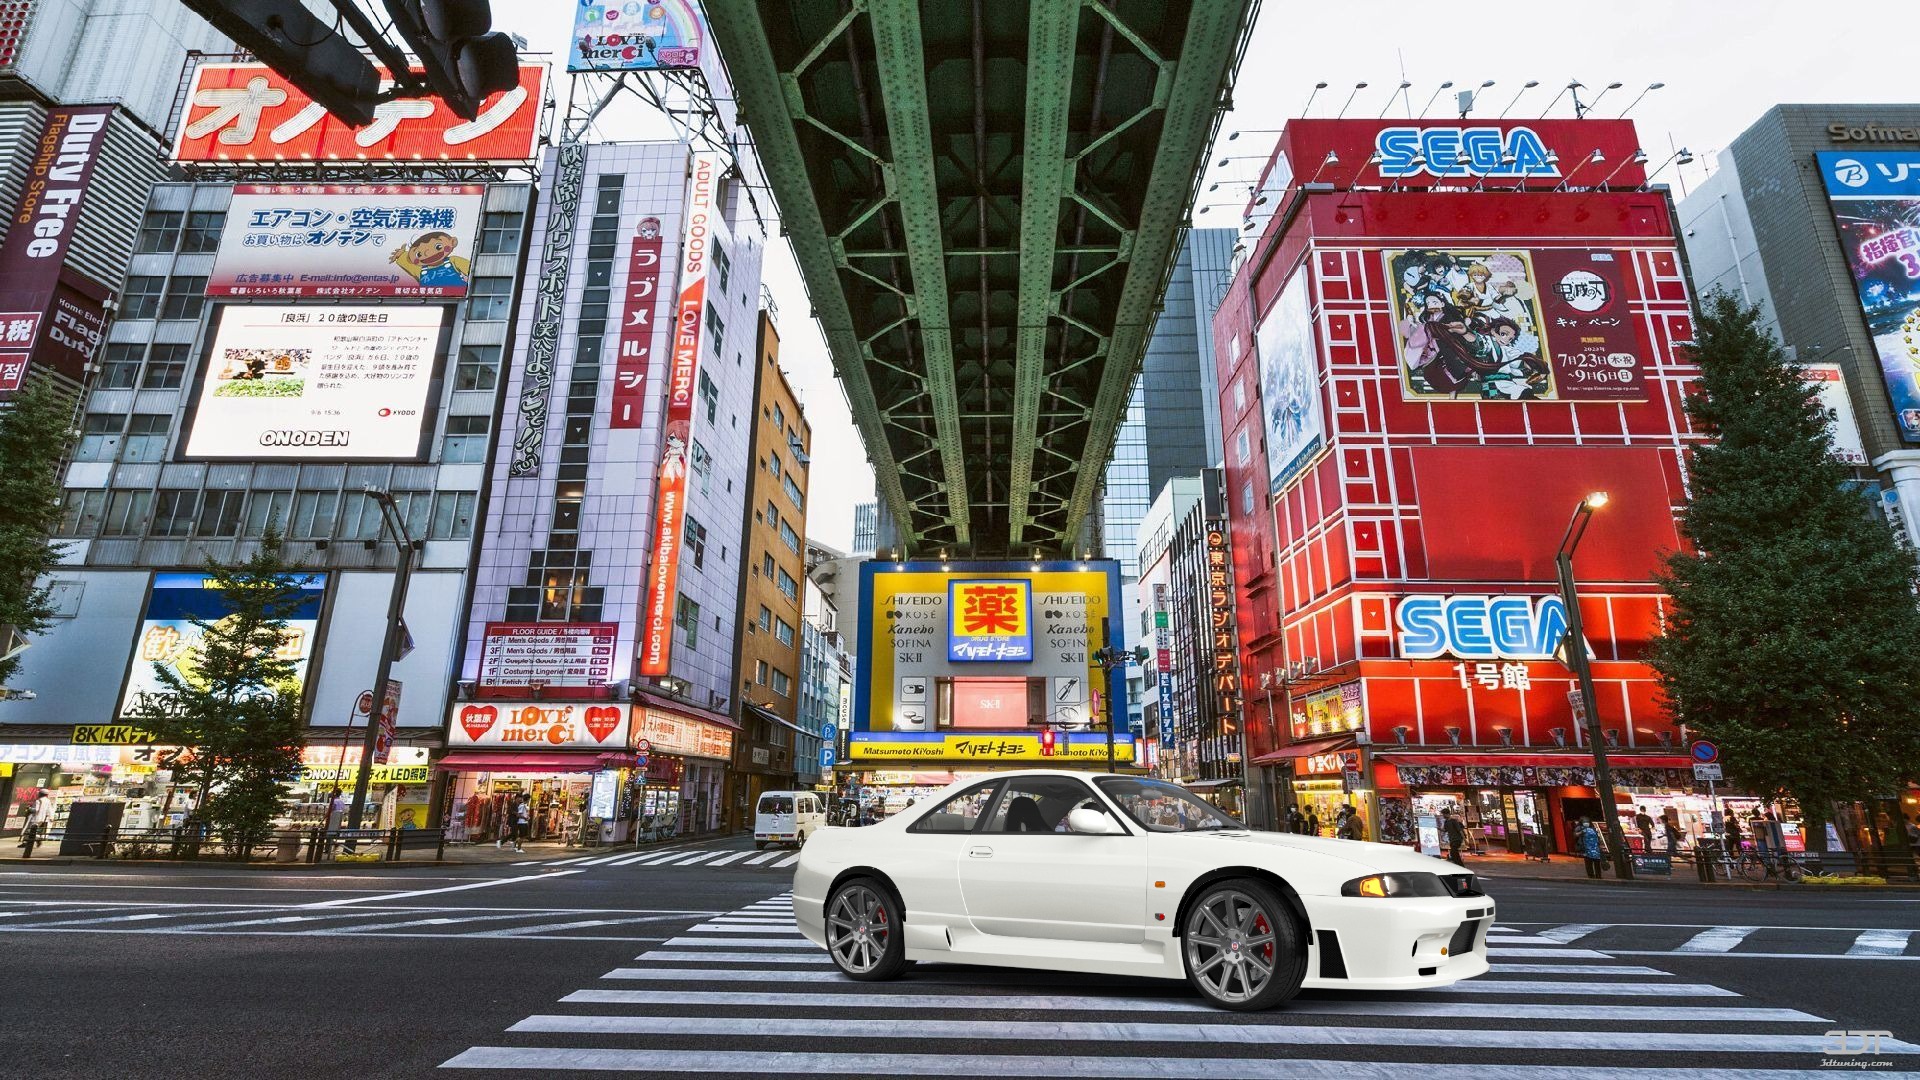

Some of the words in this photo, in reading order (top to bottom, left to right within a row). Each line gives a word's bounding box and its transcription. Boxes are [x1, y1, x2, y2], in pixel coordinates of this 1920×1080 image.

[1828, 121, 1920, 141] Sofma
[34, 114, 68, 176] Flagship
[1376, 126, 1562, 177] SEGA
[692, 159, 711, 209] ADULT
[19, 180, 45, 224] Store
[26, 189, 82, 258] Free
[686, 213, 706, 274] GOODS
[236, 273, 294, 283] 広告募集中
[680, 300, 698, 347] LOVE
[620, 249, 658, 421] ラブメルシー
[673, 349, 693, 407] MERCI
[260, 430, 350, 447] ONODEN
[649, 491, 676, 665] www.akibalovemerci.com
[880, 595, 943, 606] SHISEIDO
[963, 585, 1019, 634] 薬
[1040, 595, 1101, 606] SHISEIDO
[512, 628, 535, 636] FLOOR
[536, 628, 558, 636] GUIDE
[887, 623, 935, 635] Kanebo
[1046, 623, 1095, 635] Kanebo
[1396, 595, 1597, 660] SEGA
[490, 647, 501, 655] 3F
[890, 639, 932, 648] SOFINA
[953, 642, 1028, 660] マツモトキヨシ
[1050, 639, 1093, 648] SOFINA
[1209, 551, 1237, 734] 東京ラジオデパート
[488, 657, 499, 665] 2F
[488, 668, 497, 676] 1F
[503, 668, 534, 676] Costume
[1453, 662, 1531, 691] 1号館
[509, 706, 569, 726] LOVE
[75, 727, 99, 743] 8K
[104, 727, 130, 743] 4K
[823, 750, 833, 765] P
[863, 747, 912, 755] Matsumoto
[912, 747, 945, 755] KiYoshi
[955, 740, 1027, 758] マツモトキヨシ
